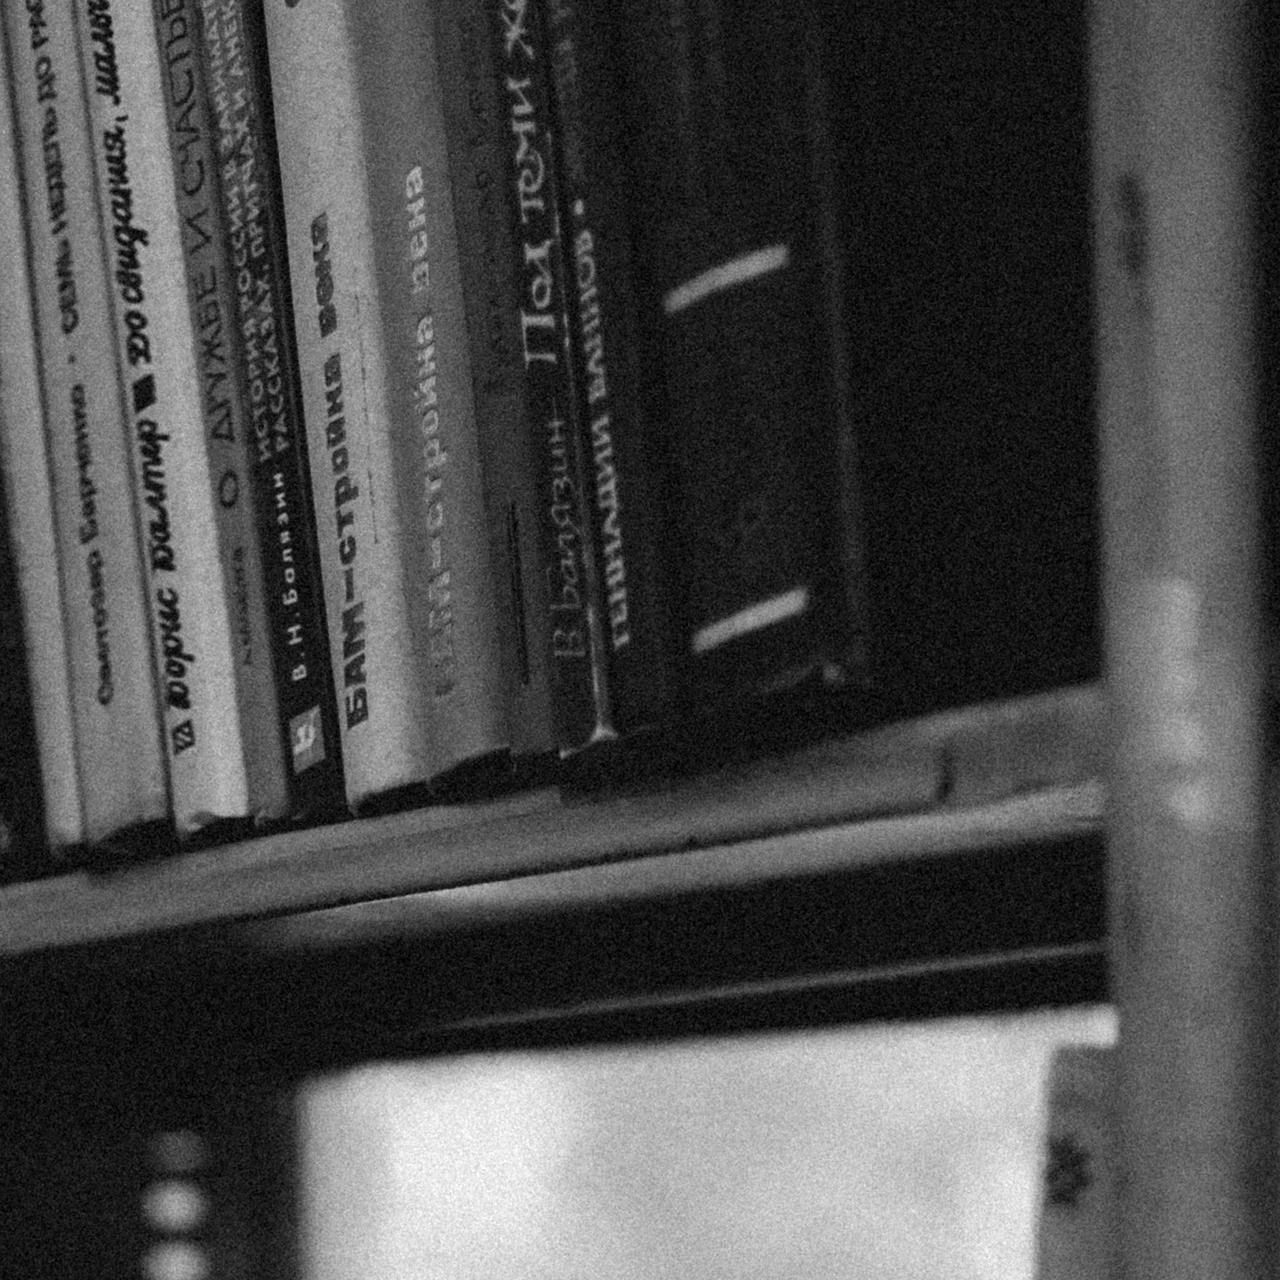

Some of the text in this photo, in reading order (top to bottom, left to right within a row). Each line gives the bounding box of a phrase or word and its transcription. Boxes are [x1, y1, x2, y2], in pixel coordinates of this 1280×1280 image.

[33, 55, 57, 103] ДО
[39, 107, 69, 234] НЕДЕЛЬ
[100, 112, 153, 303] свидания,
[505, 75, 548, 224] теми
[54, 238, 80, 335] СЕМЬ
[184, 206, 212, 255] И
[193, 264, 235, 444] ДРУЖБЕ
[520, 238, 560, 371] Под
[135, 416, 183, 573] Балтер
[215, 468, 241, 508] О
[591, 414, 630, 649] ГЕННАДИЙ
[153, 585, 199, 711] Борис
